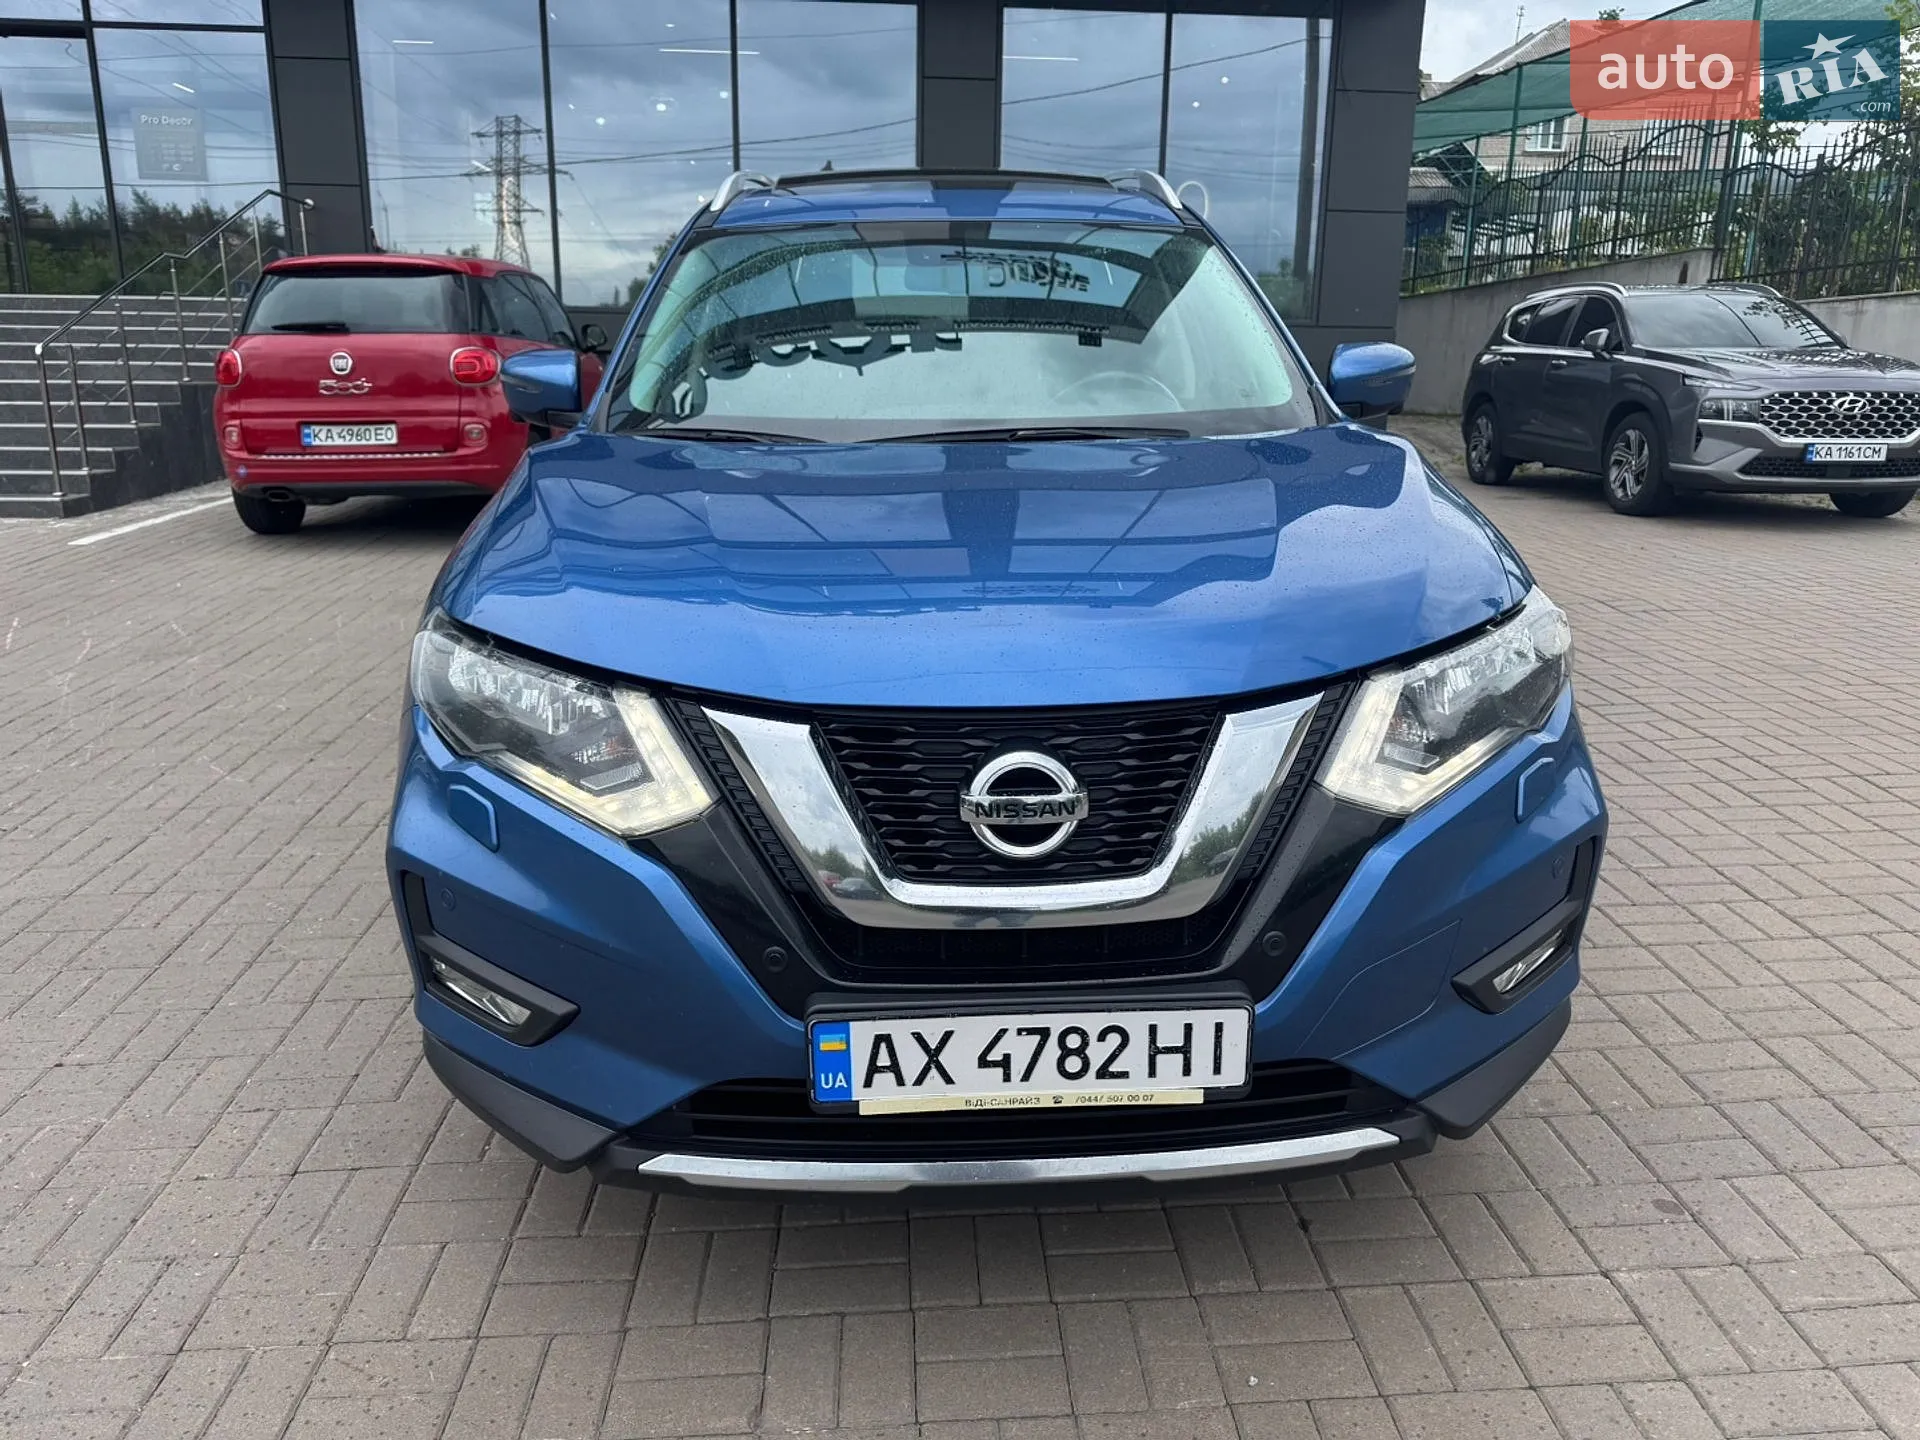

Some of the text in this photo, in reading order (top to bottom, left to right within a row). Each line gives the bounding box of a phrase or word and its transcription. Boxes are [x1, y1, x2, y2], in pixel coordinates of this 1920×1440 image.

[140, 114, 160, 125] Pro
[973, 801, 1076, 818] NISSAN
[863, 1030, 956, 1088] AX
[820, 1074, 848, 1090] UA
